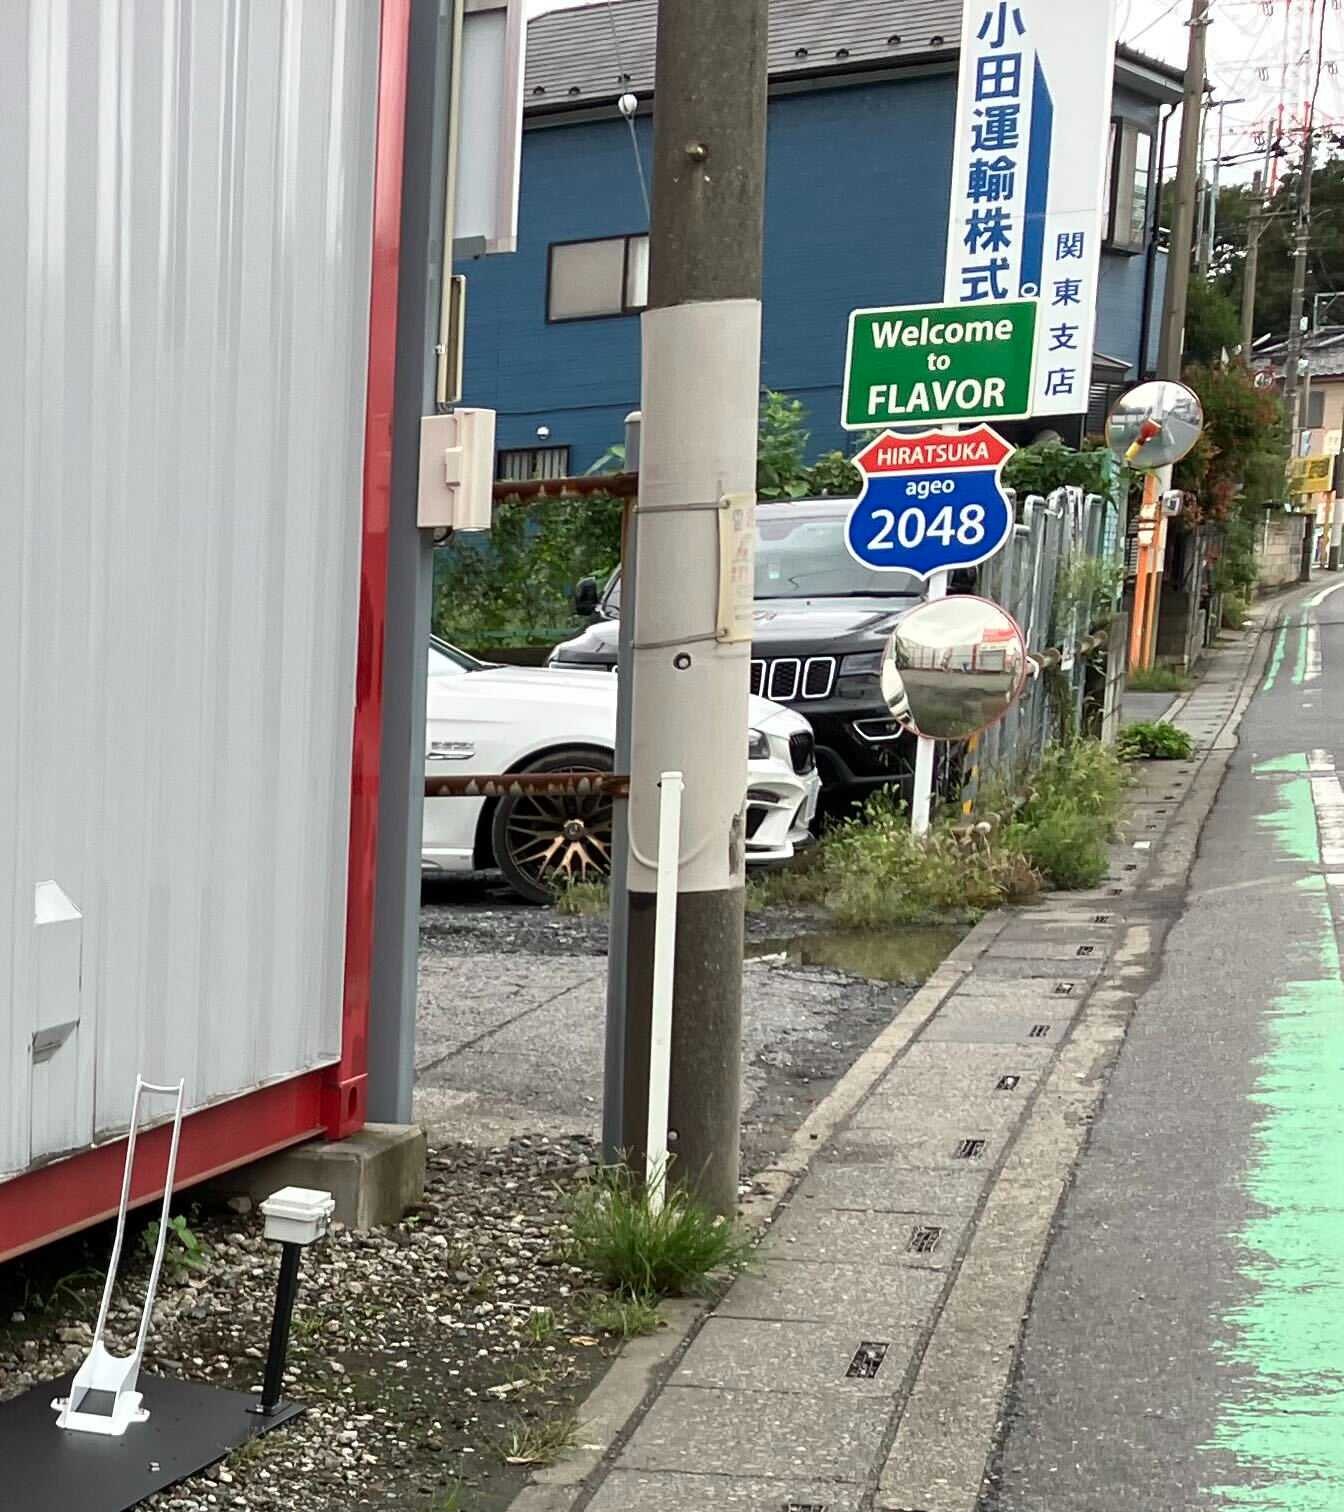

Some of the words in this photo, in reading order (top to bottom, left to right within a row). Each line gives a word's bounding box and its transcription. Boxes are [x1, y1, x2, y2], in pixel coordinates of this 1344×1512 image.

[961, 1, 1026, 303] 小田運輸株式
[1044, 231, 1085, 396] 関東支店
[871, 317, 1014, 349] Welcome
[927, 352, 951, 371] to
[867, 377, 1006, 415] FLAVOR
[877, 441, 989, 466] HIRATSUKA
[905, 479, 955, 499] ageo
[866, 504, 986, 550] 2048
